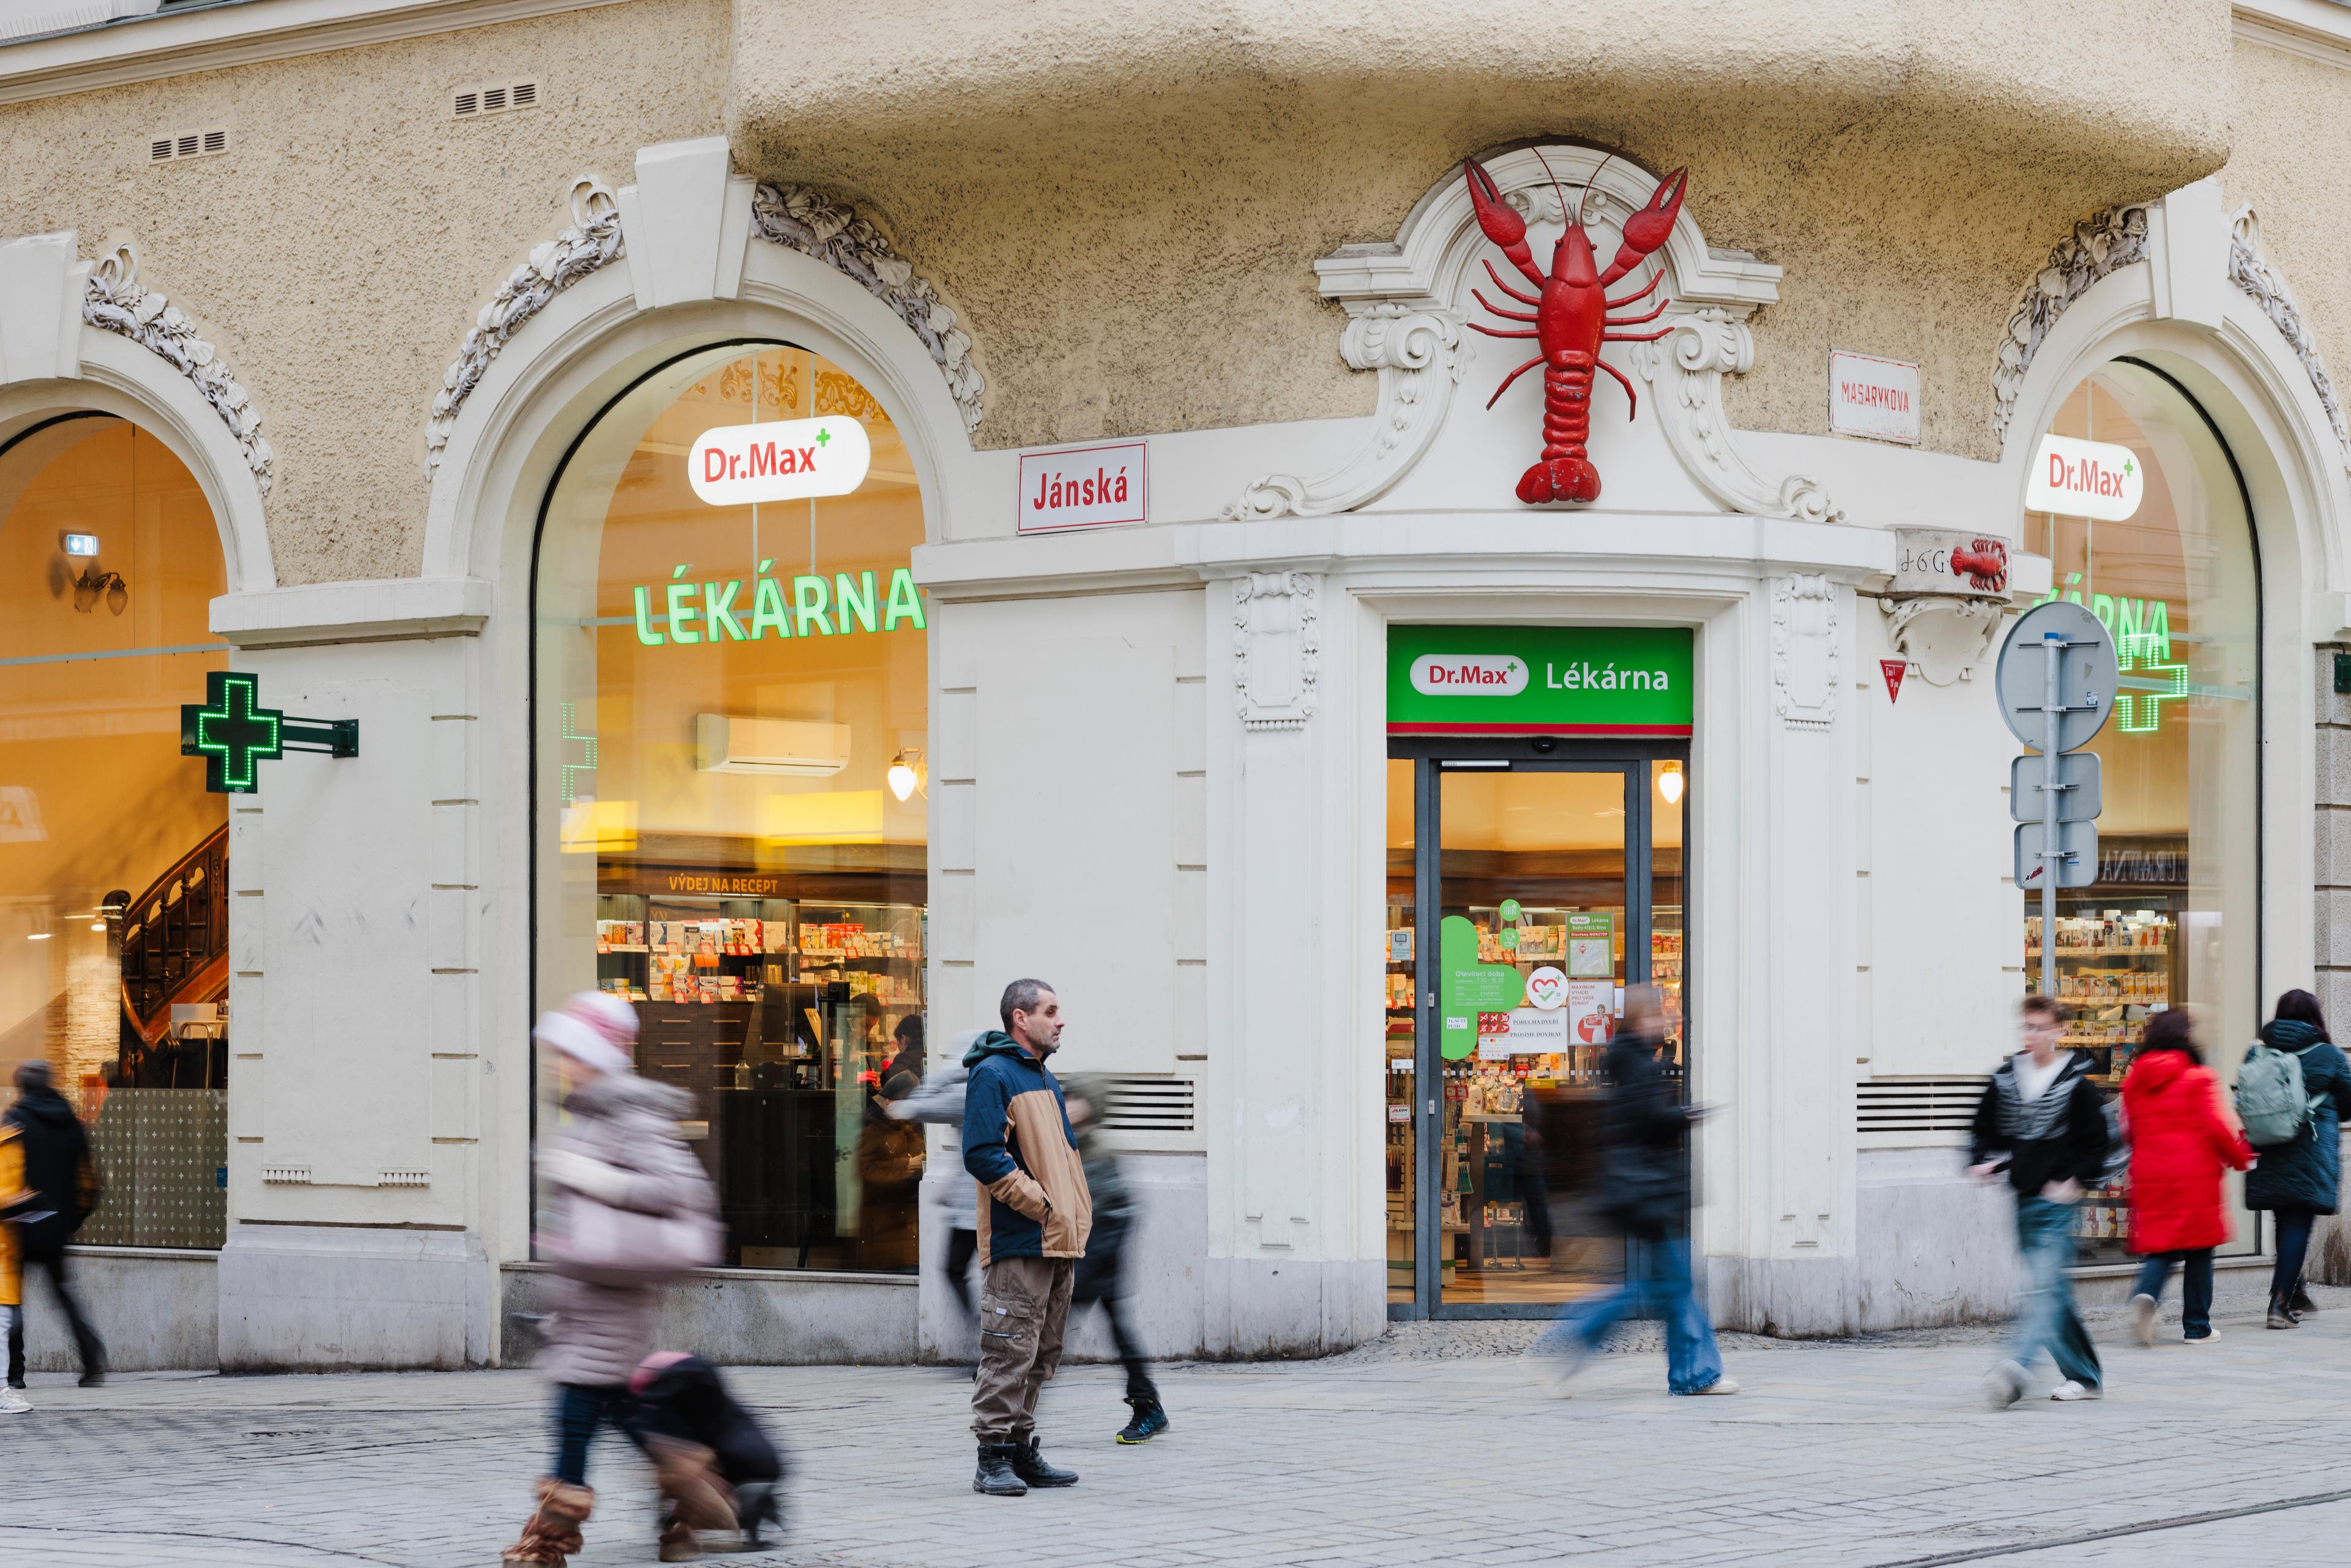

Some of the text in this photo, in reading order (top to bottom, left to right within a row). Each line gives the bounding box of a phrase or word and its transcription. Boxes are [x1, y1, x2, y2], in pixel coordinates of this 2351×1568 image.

[1841, 380, 1910, 413] MASARYKOVA
[704, 441, 816, 483] Dr.Max
[2049, 453, 2124, 499] Dr.Max
[1033, 466, 1128, 510] Jánská
[634, 558, 927, 646] LÉKÁRNA
[1429, 662, 1669, 691] Dr.Max Lékárna
[669, 872, 778, 893] VÝDEJ NA RECEPT
